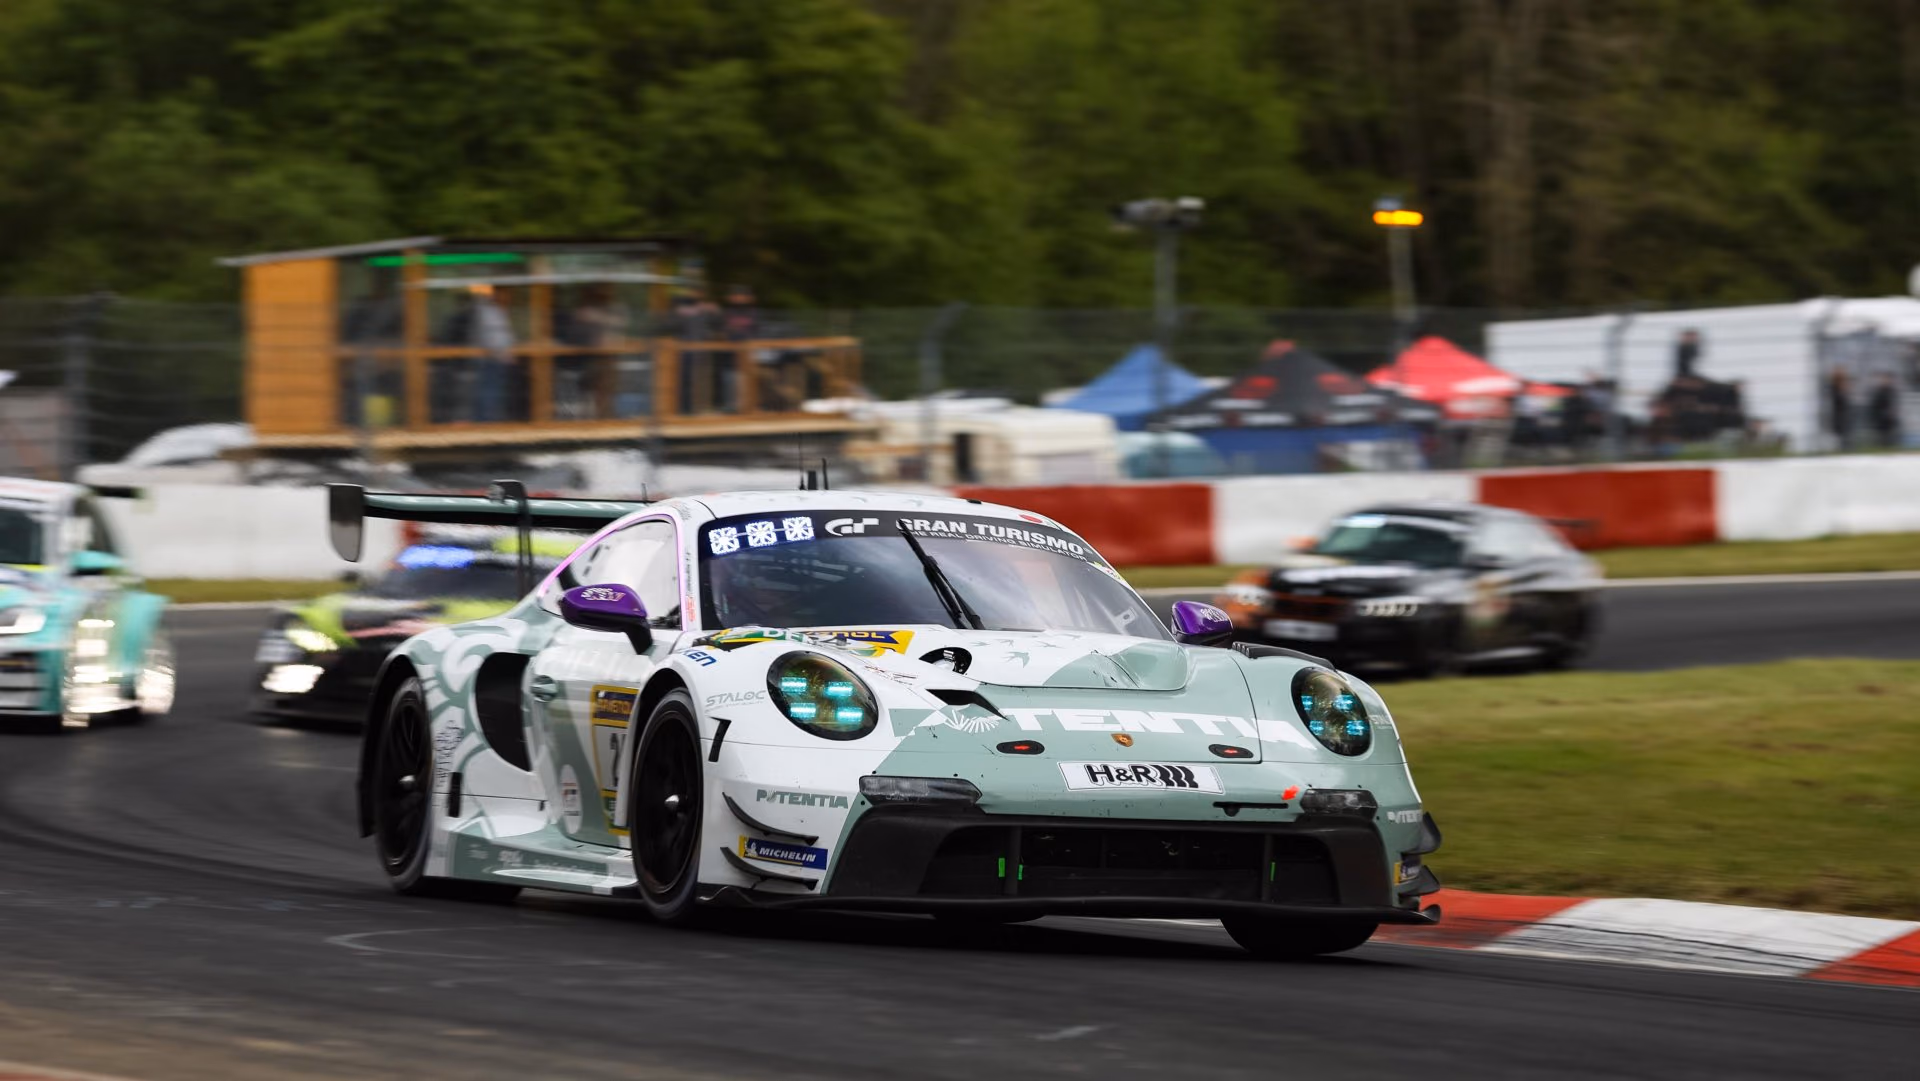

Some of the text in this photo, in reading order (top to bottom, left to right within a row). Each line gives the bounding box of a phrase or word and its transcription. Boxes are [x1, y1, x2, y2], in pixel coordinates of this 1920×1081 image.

[896, 518, 1084, 556] GRAN TURISMO
[965, 533, 1016, 545] DRIVING
[1018, 540, 1087, 562] SIMULATOR
[705, 690, 766, 708] STALOC
[1084, 764, 1160, 785] H&R
[759, 847, 817, 862] MICHELIN
